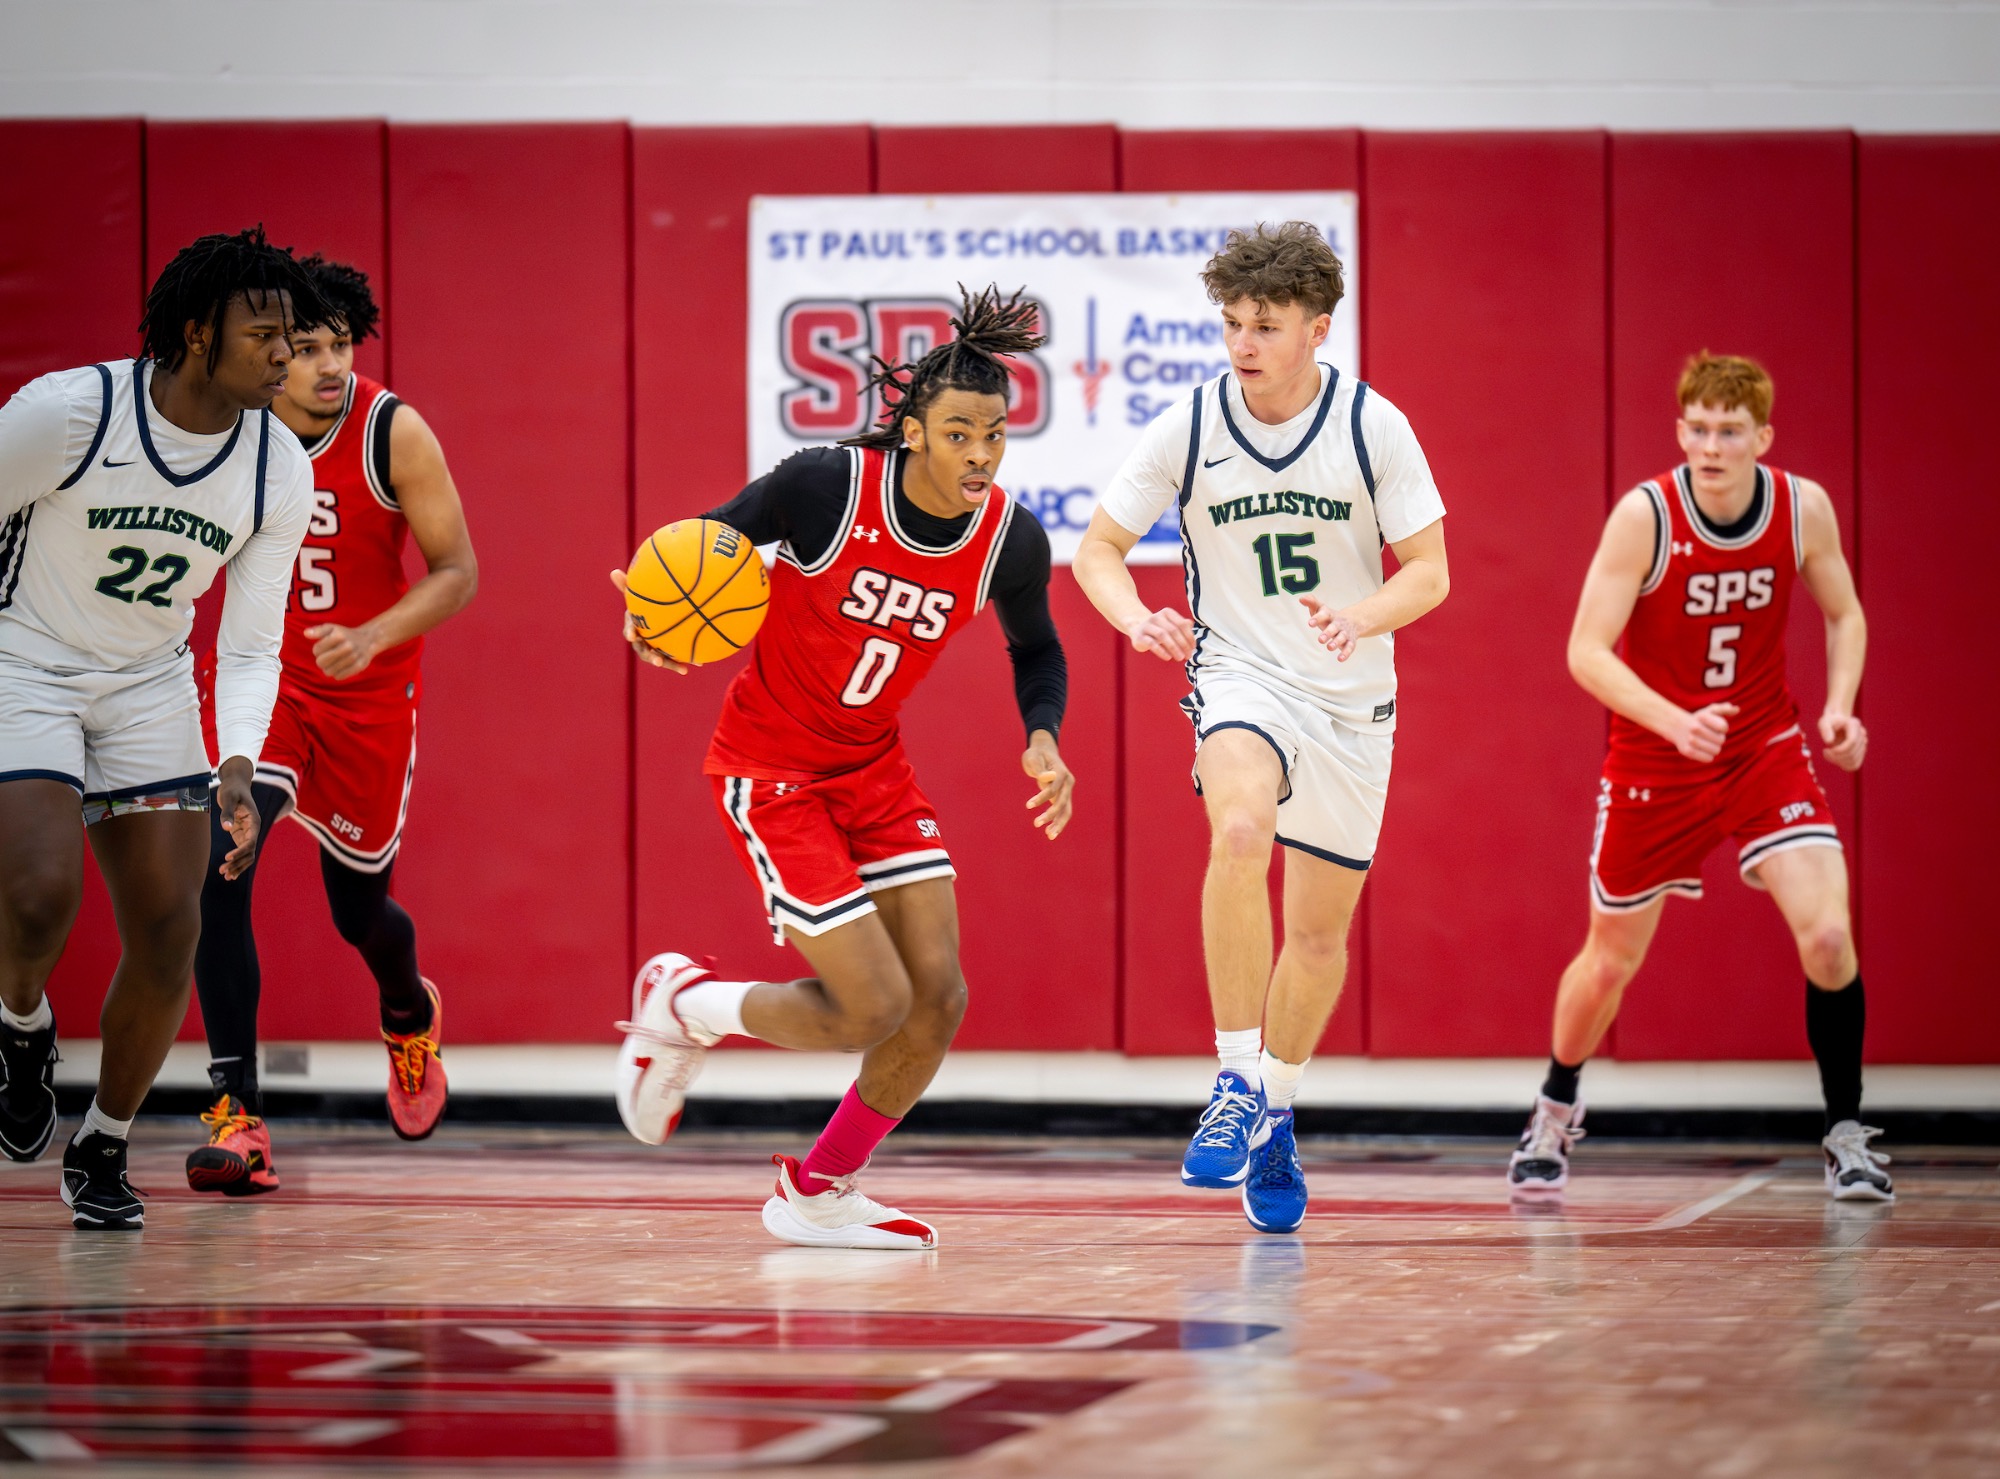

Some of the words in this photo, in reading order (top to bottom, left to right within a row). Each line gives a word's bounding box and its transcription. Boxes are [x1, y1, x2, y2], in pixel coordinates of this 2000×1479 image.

[768, 230, 809, 259] ST
[820, 230, 947, 259] PAUL'S
[957, 229, 1107, 258] SCHOOL
[87, 505, 234, 556] WILLISTON
[1207, 490, 1352, 527] WILLISTON
[94, 544, 191, 608] 22
[1251, 531, 1321, 597] 15
[839, 566, 957, 643] SPS
[1683, 566, 1776, 617] SPS
[839, 634, 904, 709] 0
[1703, 623, 1743, 689] 5
[330, 812, 364, 842] SPS
[1779, 801, 1816, 825] SPS
